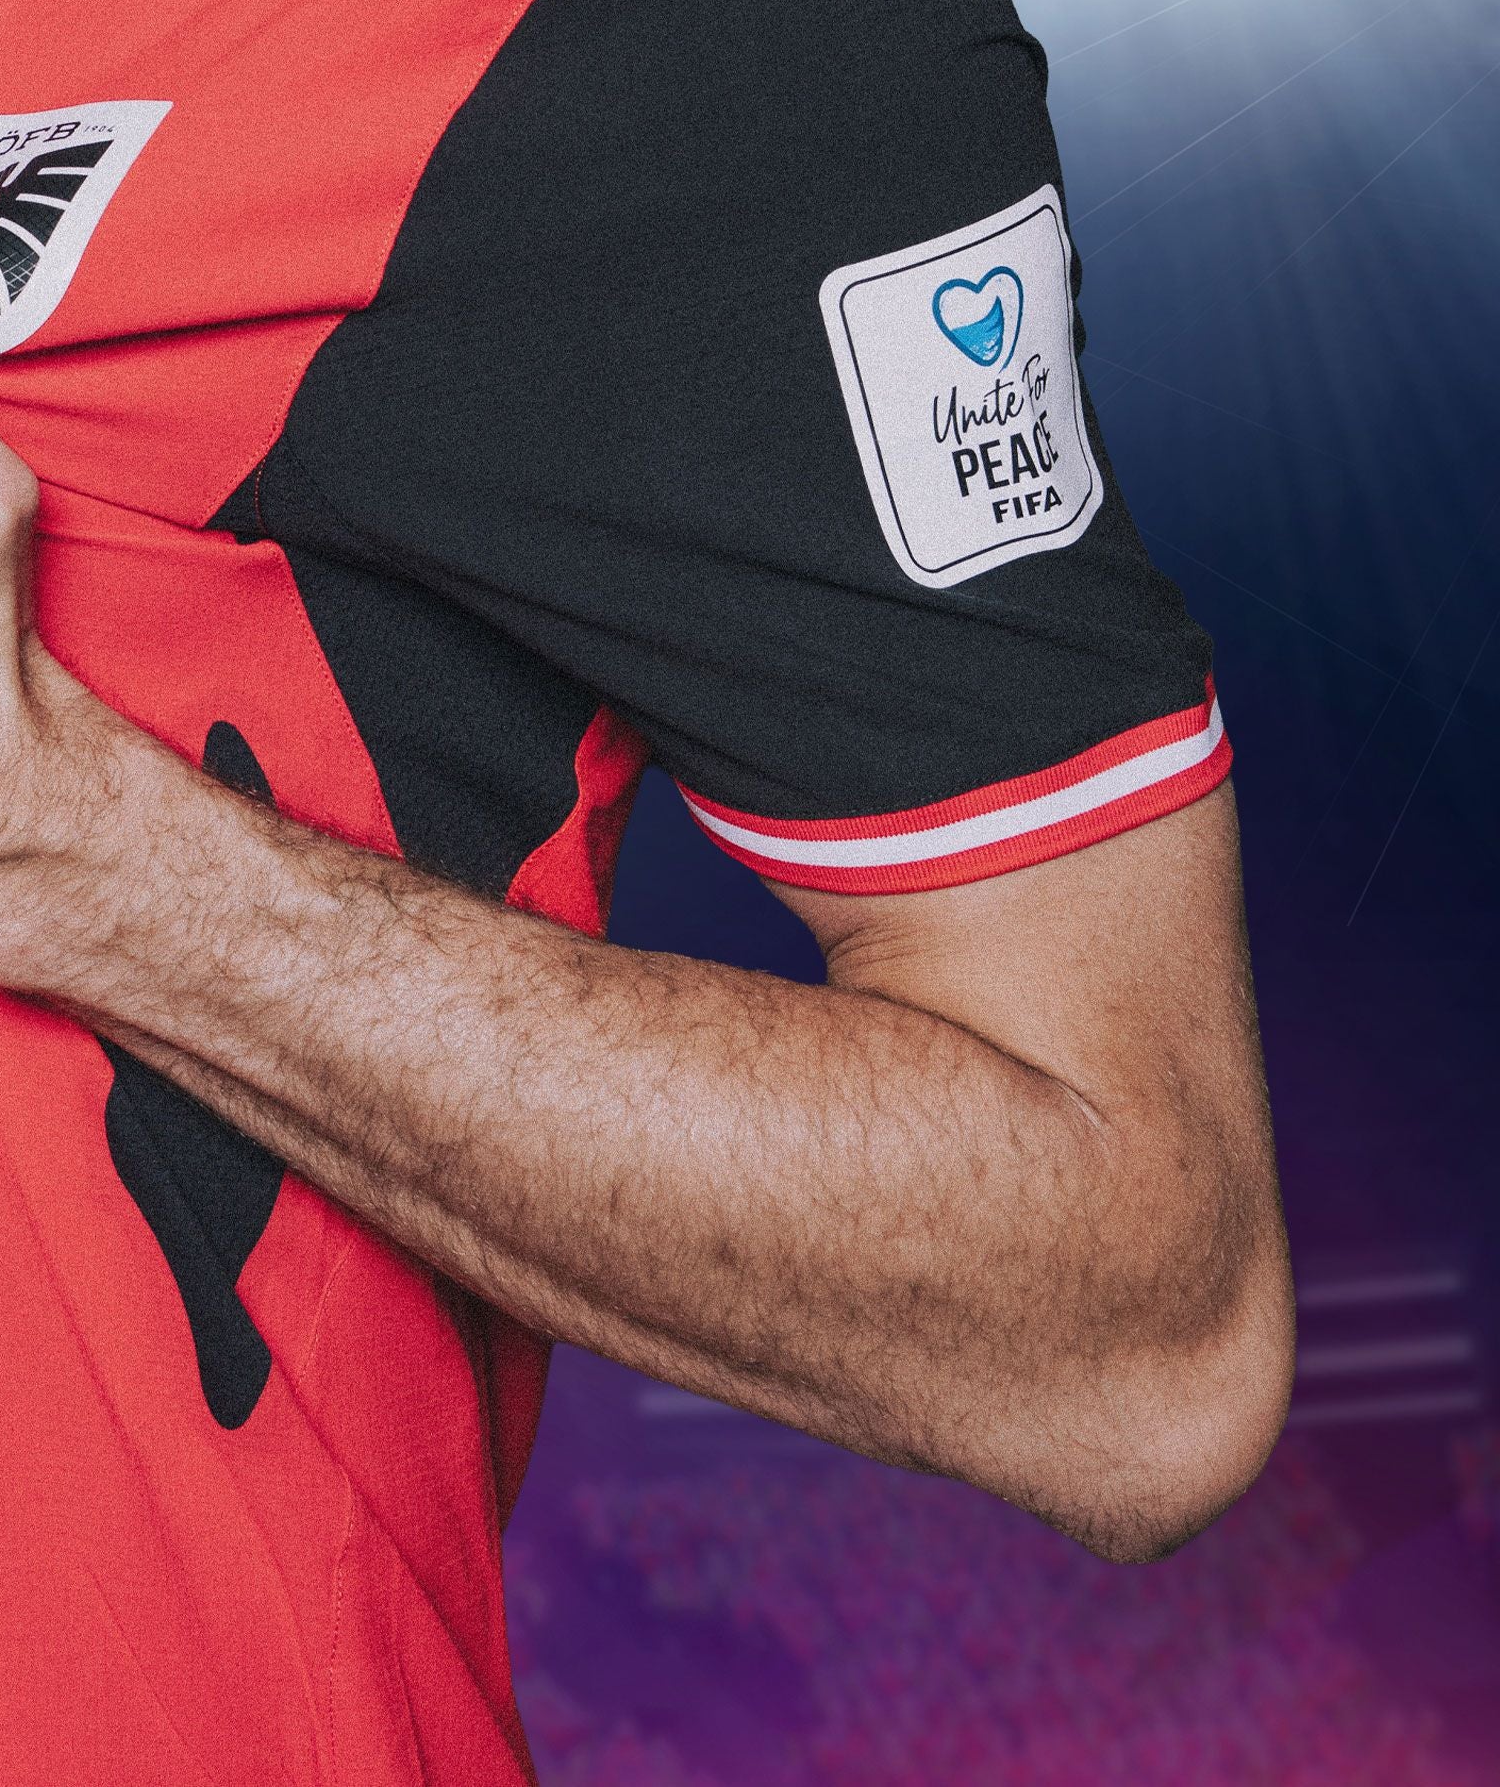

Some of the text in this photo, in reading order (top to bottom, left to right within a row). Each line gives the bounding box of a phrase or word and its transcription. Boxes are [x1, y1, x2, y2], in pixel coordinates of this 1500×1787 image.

[933, 353, 1051, 445] Unite For
[951, 410, 1060, 498] PEACE
[991, 485, 1063, 523] FIFA
